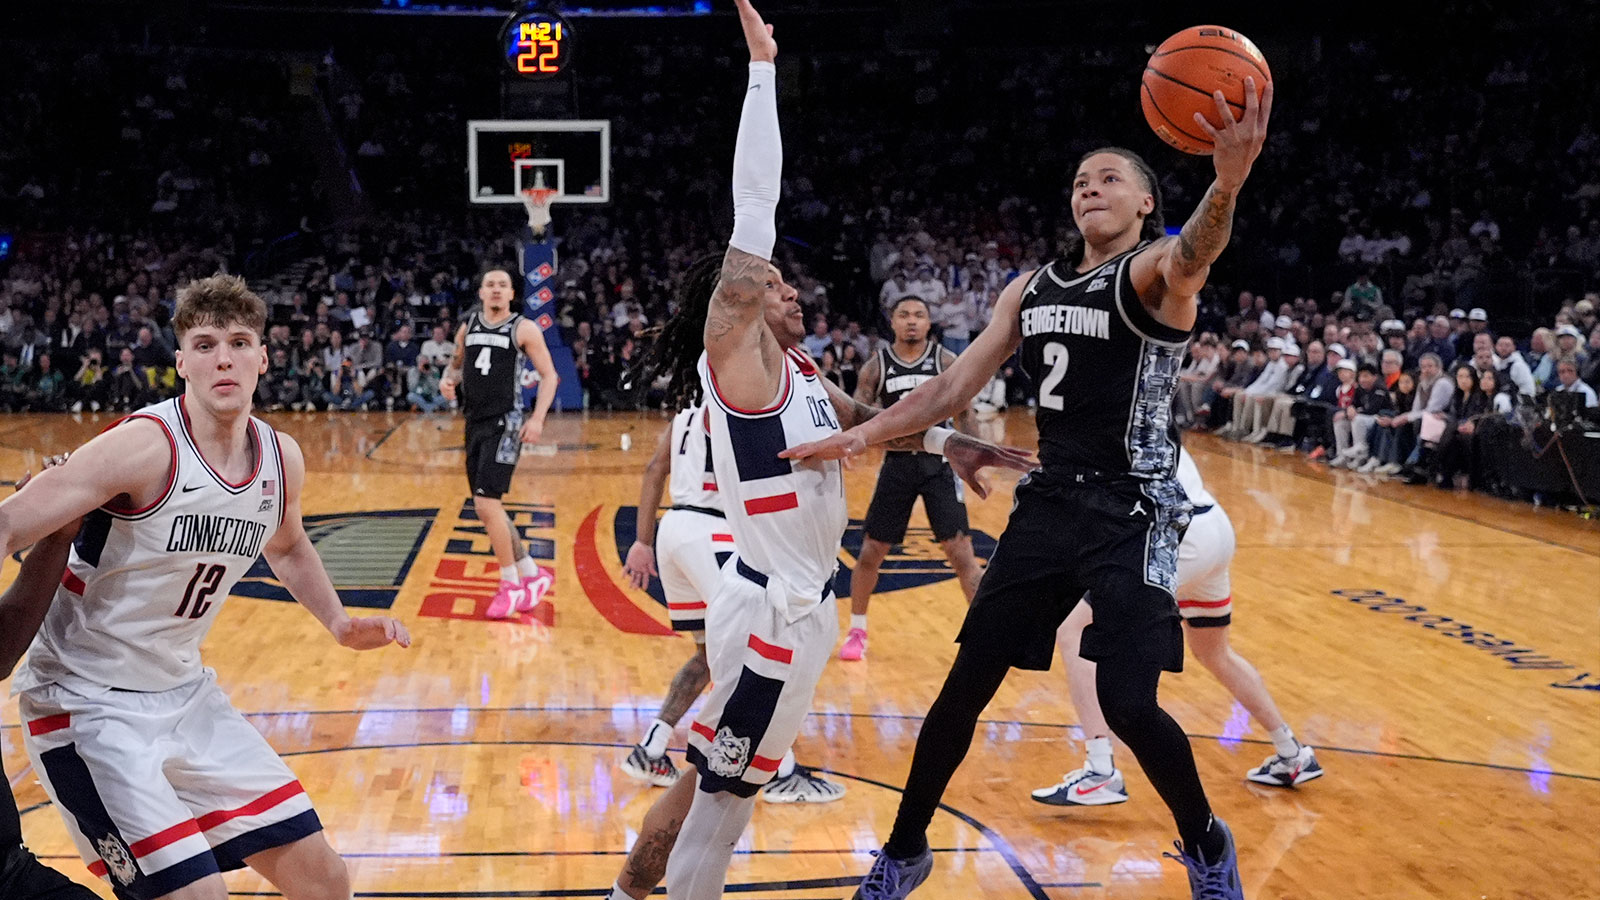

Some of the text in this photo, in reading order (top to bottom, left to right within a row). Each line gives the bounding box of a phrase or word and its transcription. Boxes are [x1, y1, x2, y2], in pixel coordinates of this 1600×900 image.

[519, 22, 562, 41] 14:21
[517, 40, 560, 73] 22
[474, 346, 492, 376] 4
[1039, 341, 1070, 412] 2
[166, 514, 267, 559] CONNECTICUT
[174, 562, 227, 619] 12
